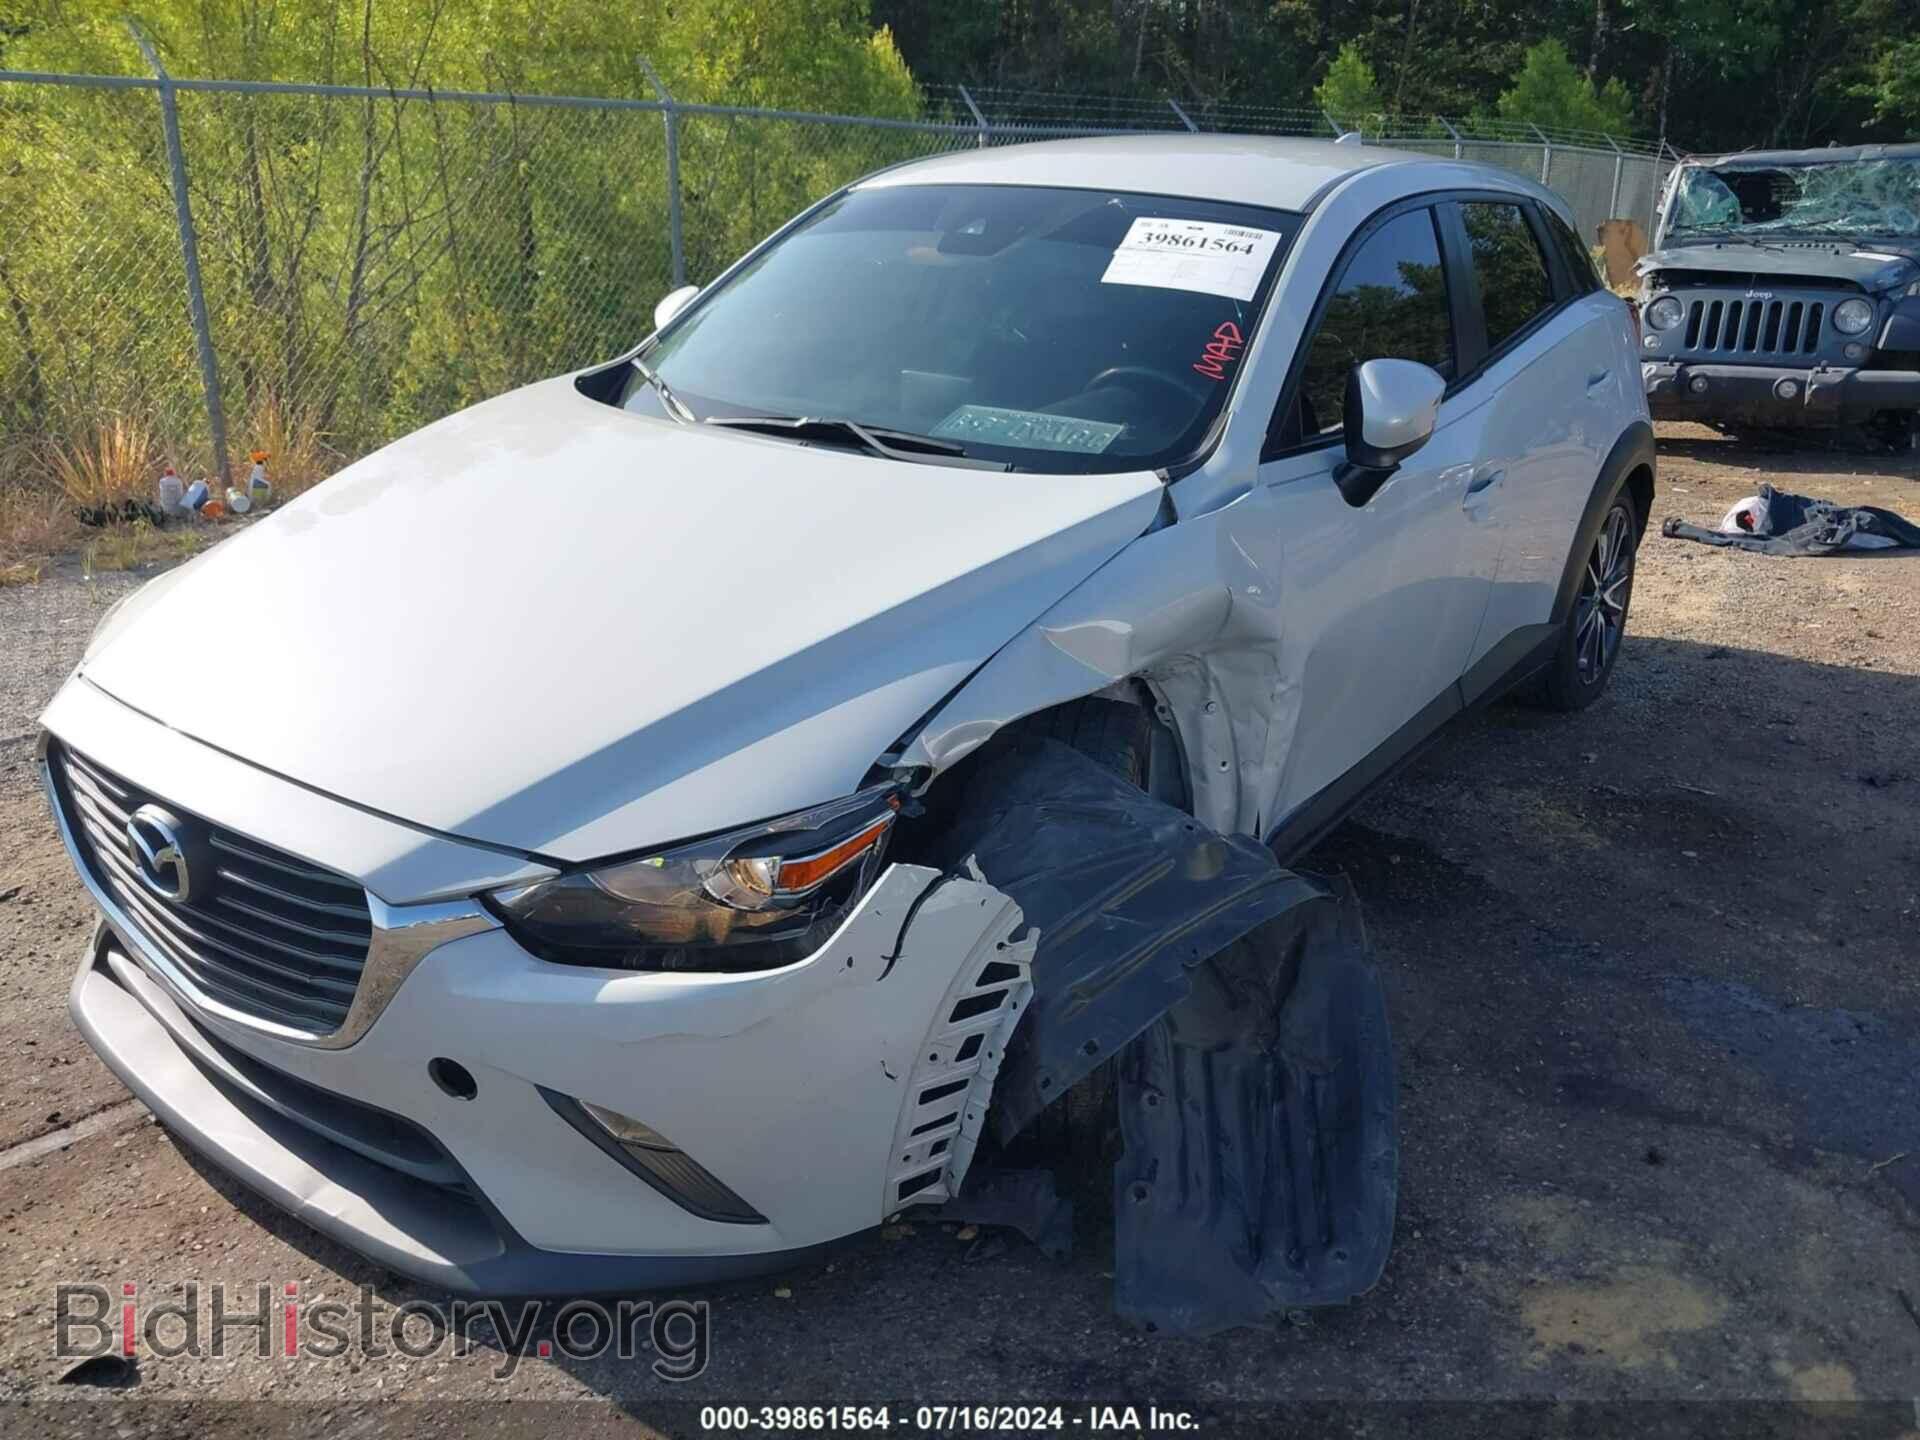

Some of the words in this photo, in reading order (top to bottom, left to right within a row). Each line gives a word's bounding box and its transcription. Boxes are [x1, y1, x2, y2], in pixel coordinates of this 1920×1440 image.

[1138, 231, 1255, 255] 39861564
[1745, 289, 1773, 300] Jeep
[1193, 321, 1244, 380] MAD
